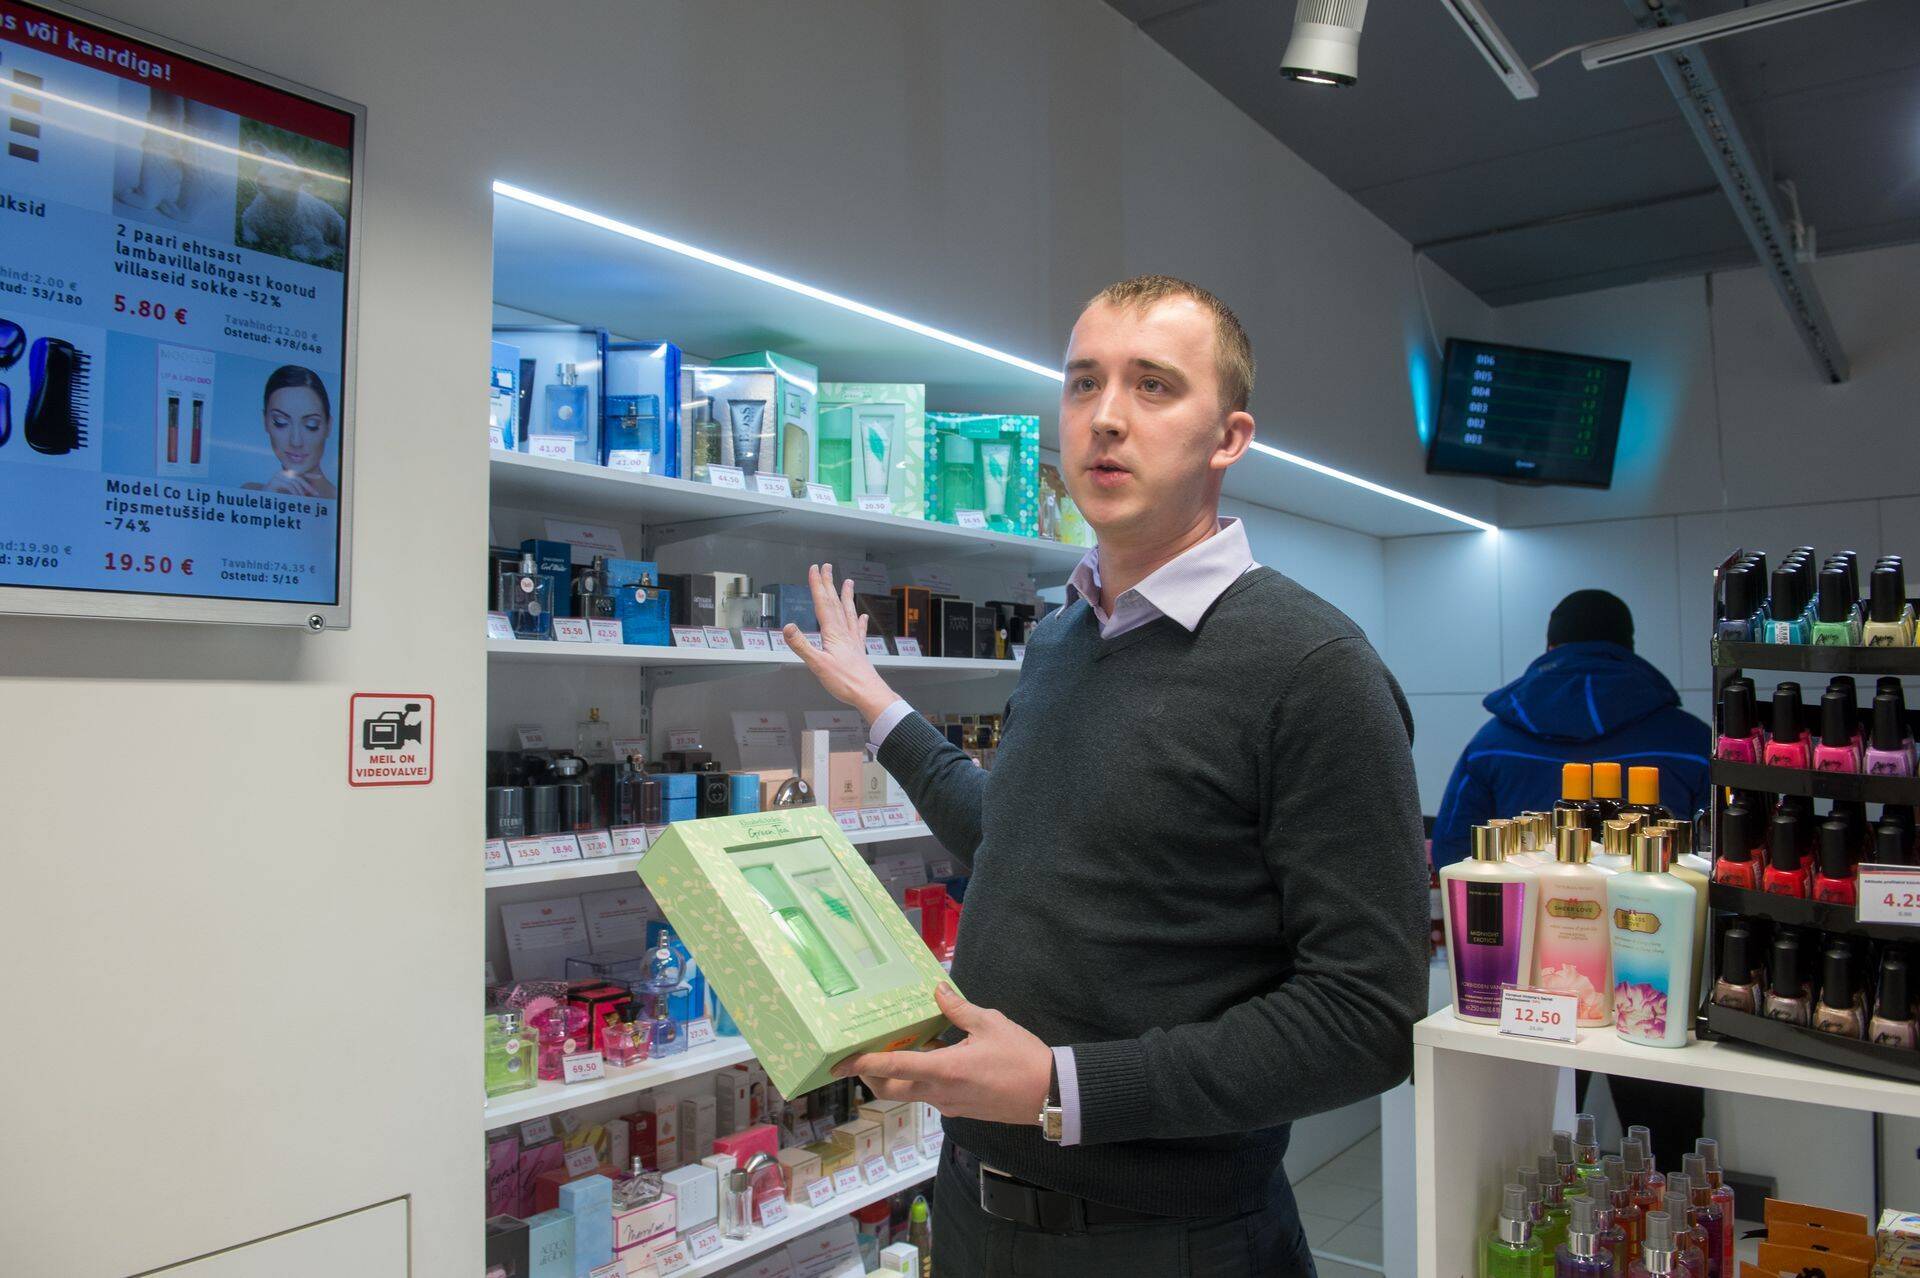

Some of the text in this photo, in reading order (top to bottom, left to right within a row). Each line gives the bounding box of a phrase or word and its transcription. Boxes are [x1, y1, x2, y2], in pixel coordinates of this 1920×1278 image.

[24, 20, 58, 45] või
[67, 31, 172, 81] kaardiga!
[117, 224, 242, 265] 2 paari ehtsast
[115, 240, 317, 300] lambavillalõngast kootud
[69, 281, 79, 292] €
[114, 259, 282, 309] villaseid sokke -52%
[31, 286, 83, 306] 53/180
[114, 294, 188, 325] 5.80 €
[224, 326, 271, 347] Ostetud:
[106, 479, 328, 517] Model Co Lip huuleläigete ja
[105, 498, 302, 531] ripsmetuššide komplekt
[105, 518, 151, 534] -74%
[64, 545, 73, 555] €
[16, 555, 58, 568] 38/60
[105, 552, 194, 576] 19.50 €
[221, 570, 299, 586] Ostetud: 5/16
[369, 754, 415, 764] MEIL ON
[356, 767, 427, 777] VIDEOVALVE!
[748, 827, 775, 839] Green
[620, 838, 641, 846] 17.90
[518, 850, 540, 858] 15.50
[1515, 1007, 1561, 1025] 12.50
[573, 1062, 597, 1074] 69.50
